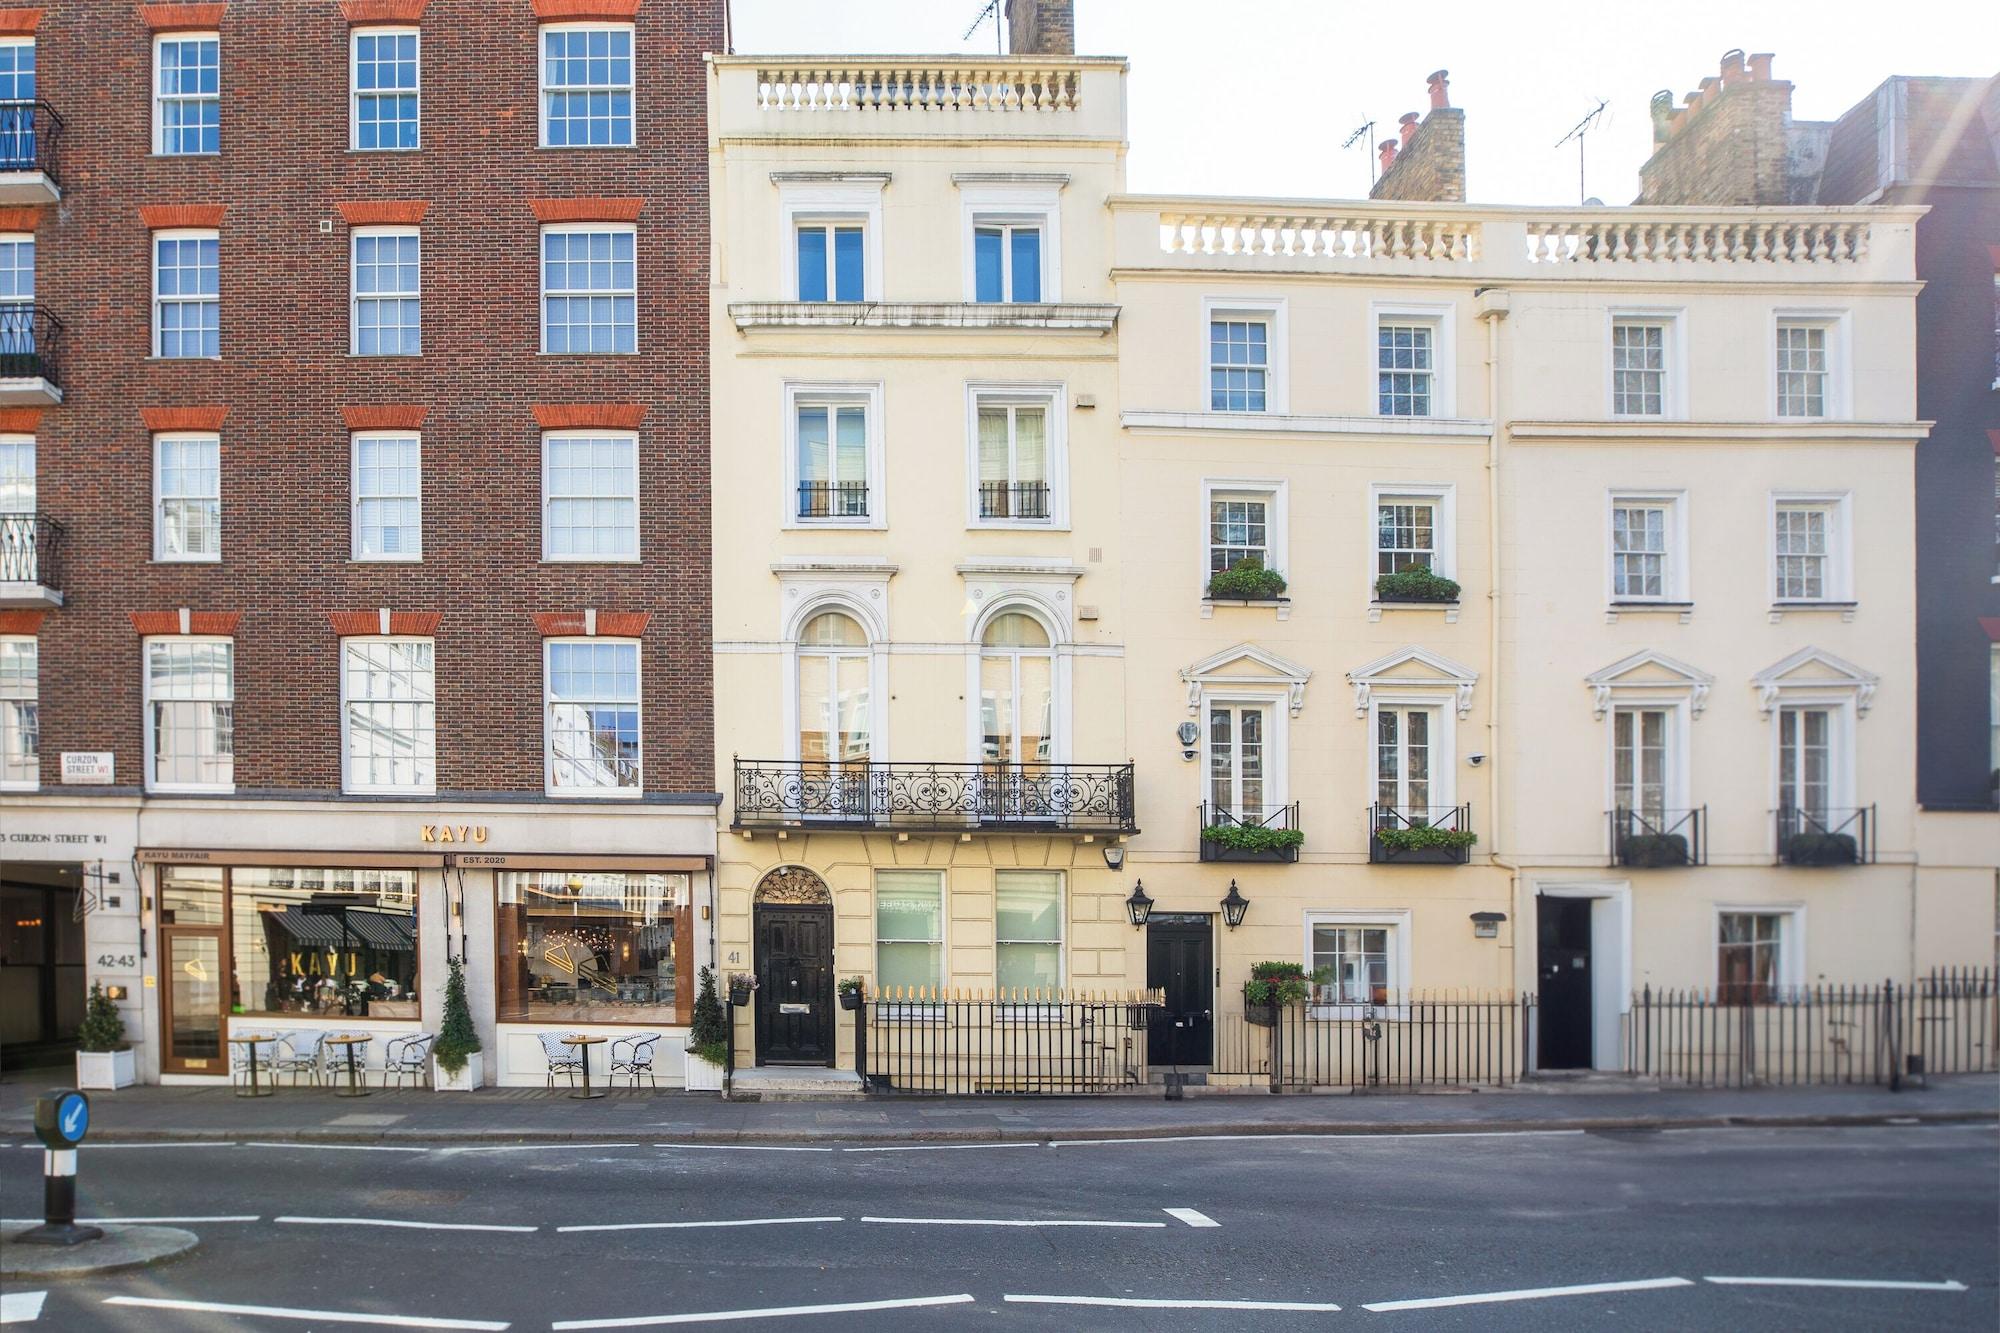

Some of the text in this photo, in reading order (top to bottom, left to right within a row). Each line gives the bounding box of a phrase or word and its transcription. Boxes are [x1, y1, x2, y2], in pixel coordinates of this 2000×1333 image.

[67, 755, 98, 764] CURZON
[66, 765, 109, 774] STREET W1
[9, 833, 51, 843] CURZON
[54, 834, 89, 844] STREET
[421, 825, 487, 843] KAYU
[144, 851, 209, 860] KAYU MAYFAIR
[463, 856, 506, 864] EST. 2020
[728, 951, 740, 964] 41
[291, 952, 356, 977] KAYU
